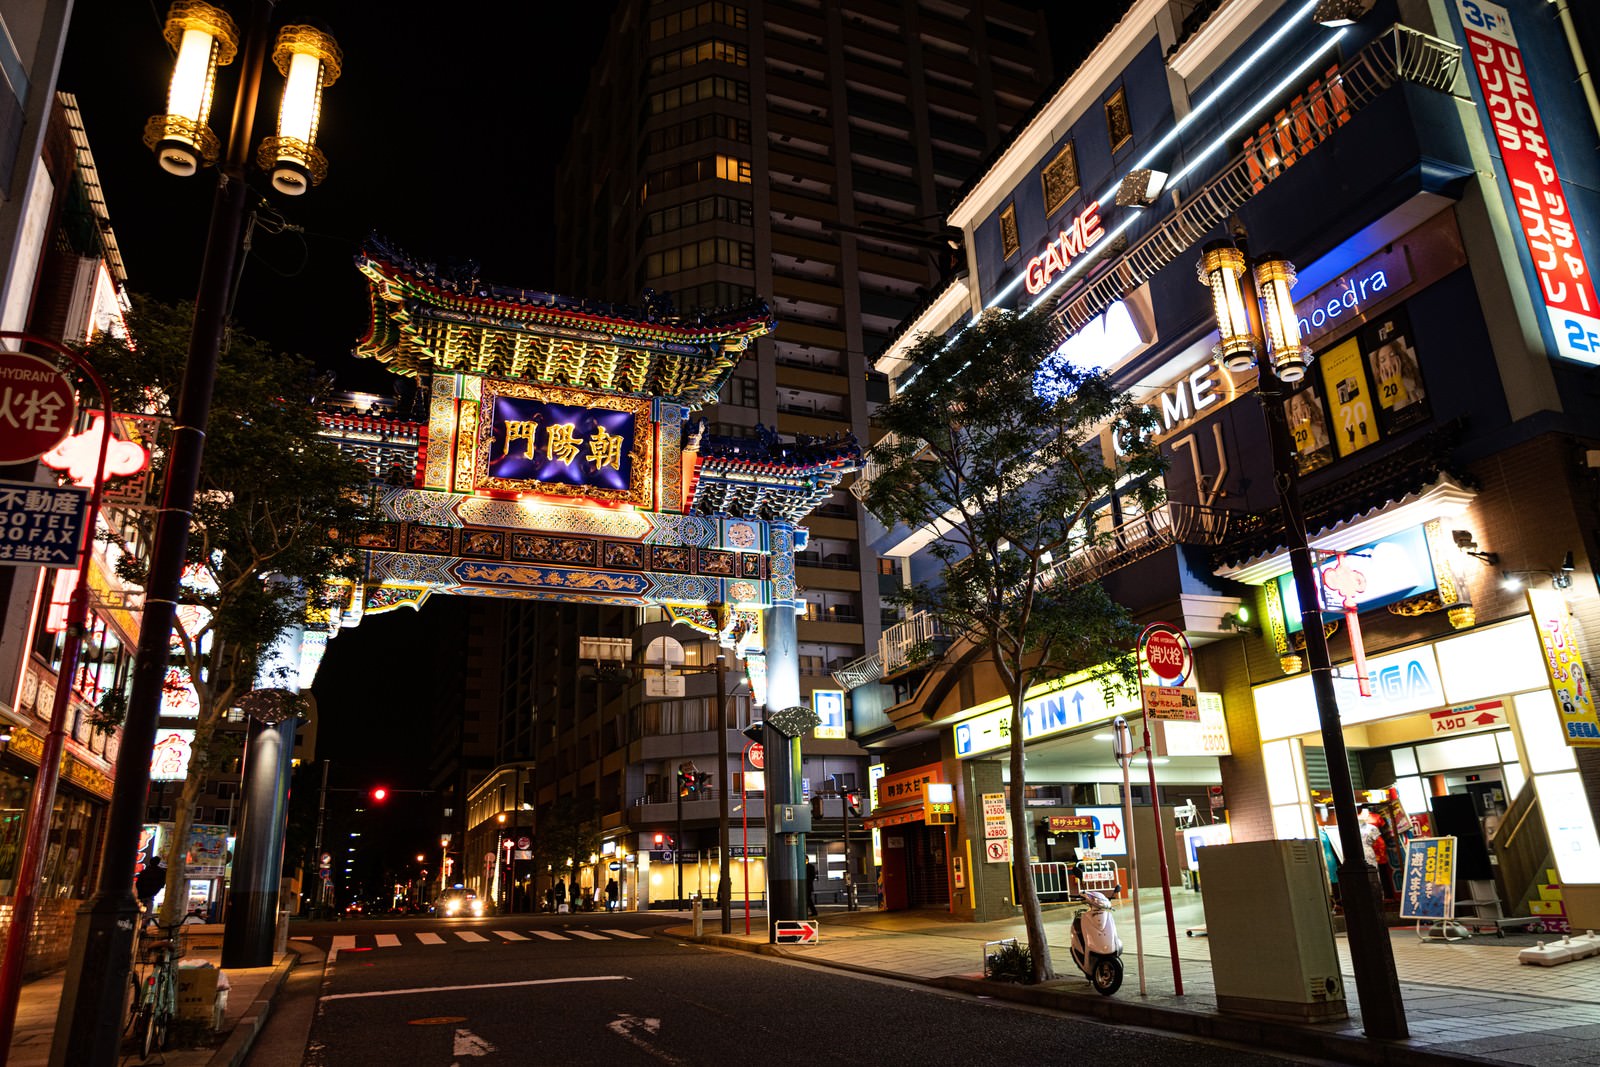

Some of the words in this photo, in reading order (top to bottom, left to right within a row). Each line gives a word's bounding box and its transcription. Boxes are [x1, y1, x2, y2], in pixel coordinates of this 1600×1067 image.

[1462, 1, 1497, 31] 3F
[1471, 36, 1522, 151] プリクラ
[1499, 47, 1591, 312] UFOキャッチャー
[1025, 200, 1105, 295] GAME
[1564, 319, 1600, 353] 2F
[1384, 383, 1398, 398] 20
[1295, 429, 1308, 443] 20
[0, 488, 80, 515] 不動産
[33, 513, 75, 530] TEL
[29, 528, 74, 544] FAX
[1149, 644, 1182, 666] 消火栓
[817, 695, 841, 727] P
[1040, 695, 1068, 731] IN
[1436, 717, 1466, 731] 入り口
[1567, 722, 1600, 738] SEGA
[1105, 825, 1117, 837] IN
